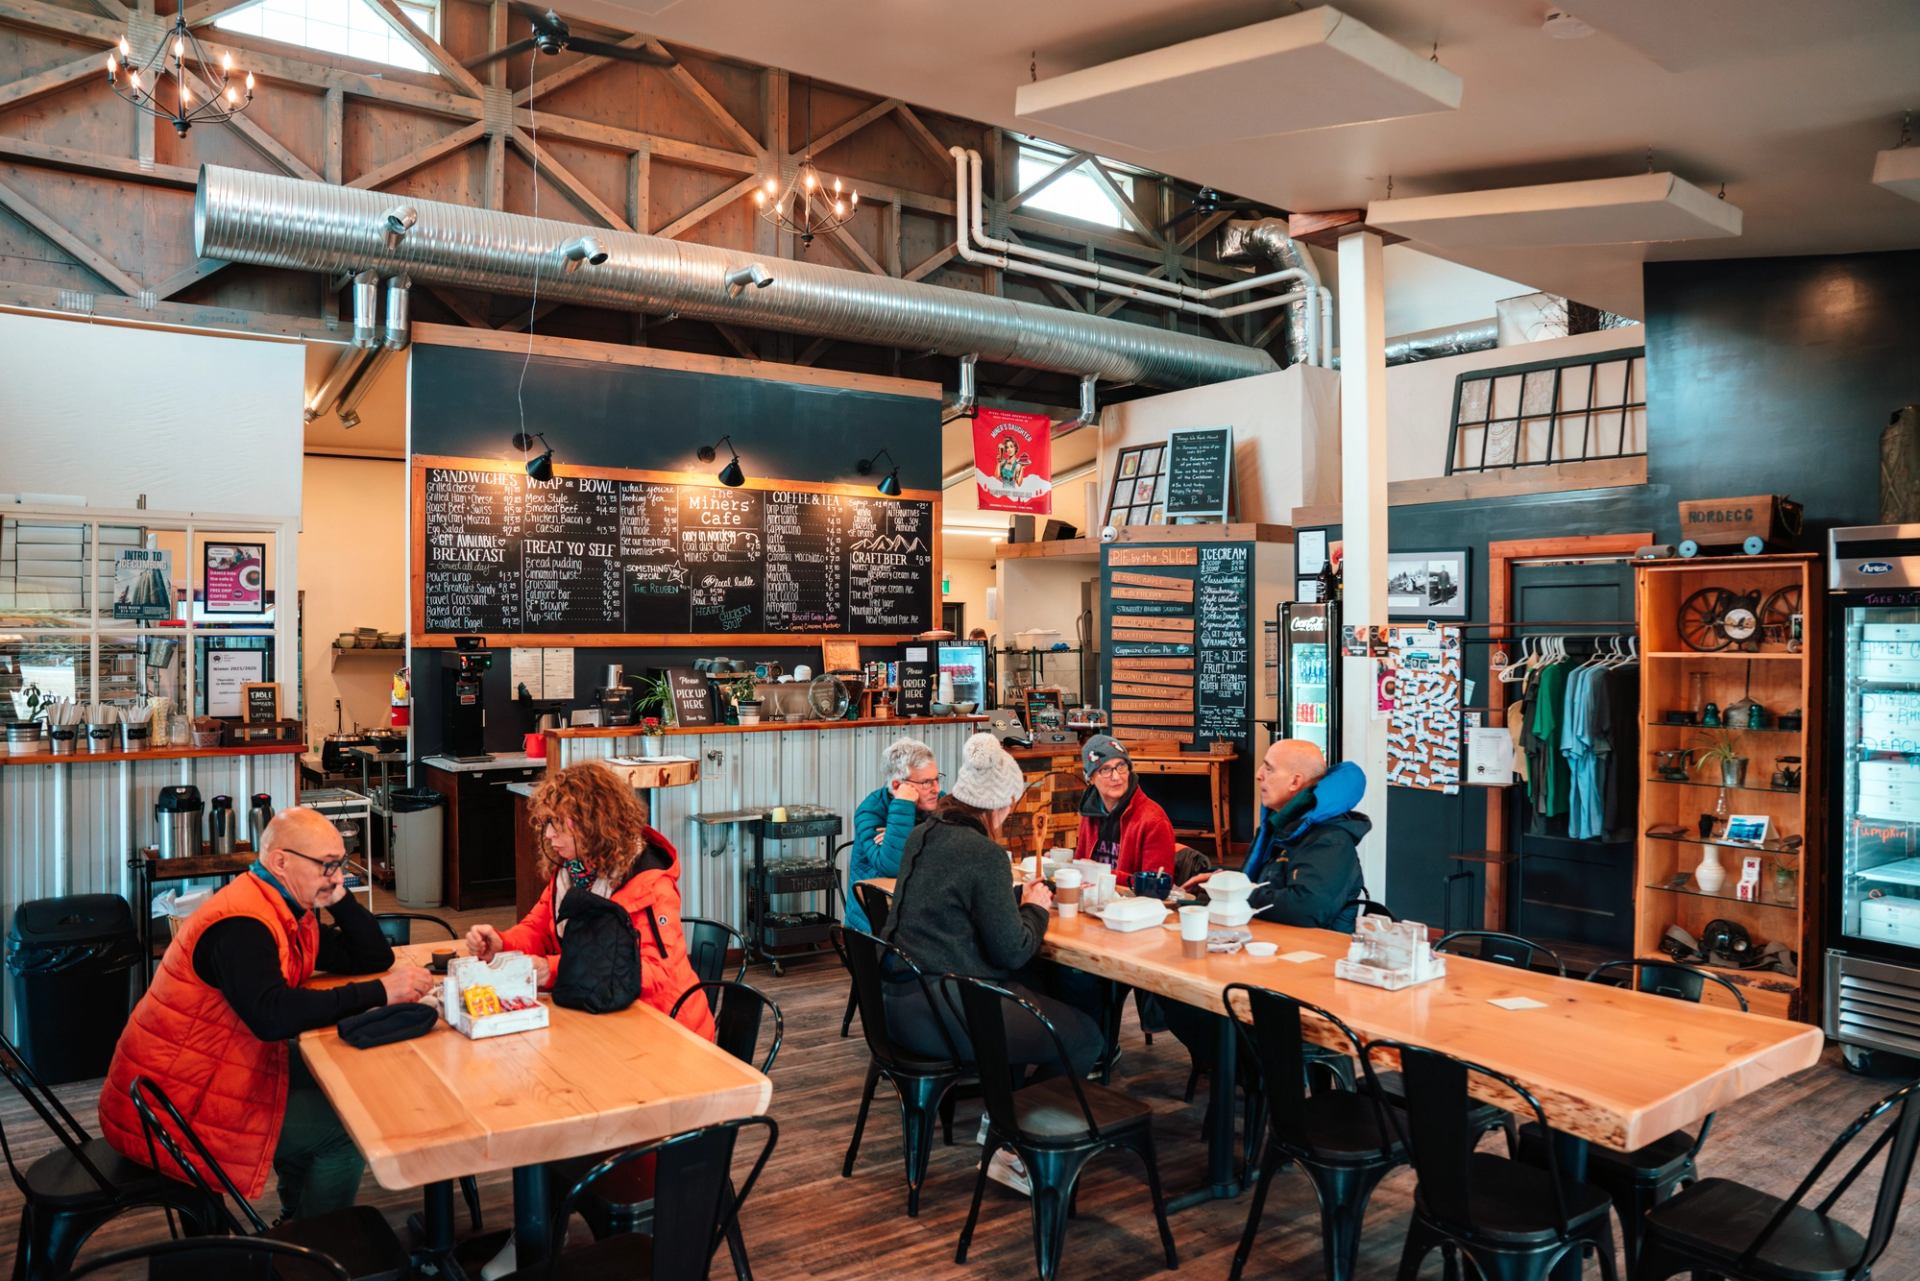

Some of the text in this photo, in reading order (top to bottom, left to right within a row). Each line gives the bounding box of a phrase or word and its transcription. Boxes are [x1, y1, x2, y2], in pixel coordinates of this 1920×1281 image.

[433, 468, 518, 487] SANDWICHES
[427, 481, 476, 494] Grilled cheese
[526, 475, 616, 494] WRAP BOWL
[621, 483, 644, 494] what
[426, 492, 449, 503] Grilled
[525, 492, 569, 506] Mexi Style
[709, 488, 734, 499] The
[772, 491, 840, 506] COFFEE & TEA
[621, 493, 665, 507] looking for
[688, 495, 755, 512] Miners'
[426, 502, 492, 515] Roast Beef Swiss
[525, 502, 579, 514] Smoked Beef
[467, 514, 490, 525] Mozza
[560, 514, 584, 525] Bacon
[621, 516, 641, 526] Cream
[701, 511, 742, 525] Cafe
[1688, 507, 1754, 524] NORDEGG
[427, 523, 465, 538] Egg Salad
[535, 524, 565, 533] Caesar
[621, 537, 635, 547] See
[635, 539, 644, 547] our
[707, 529, 736, 545] Nordegg
[524, 539, 565, 554] TREAT
[588, 542, 617, 558] SELF
[631, 547, 644, 556] oven
[682, 542, 698, 552] Coal
[699, 540, 716, 552] dust
[124, 549, 162, 562] INTRO TO
[433, 547, 506, 562] BREAKFAST
[684, 552, 728, 562] Miners' Chai
[852, 551, 908, 566] CRAFT BEER
[1112, 549, 1129, 566] PIE
[1141, 551, 1158, 562] the
[1161, 548, 1193, 565] SLICE
[474, 563, 490, 576] day
[525, 556, 582, 574] Bread pudding
[625, 564, 669, 574] SOMETHING
[427, 572, 471, 584] Power wrap
[525, 569, 558, 579] Cinnamon
[636, 571, 662, 580] SPECIAL
[766, 572, 791, 583] Matcha
[525, 579, 559, 591] Croissant
[714, 576, 732, 587] local
[426, 581, 496, 597] Best Breakfast Sandy
[525, 589, 571, 600] Eatmore Bar
[692, 588, 704, 598] Cup
[451, 592, 488, 606] Croissant
[1864, 594, 1893, 604] TAKE
[426, 605, 472, 616] Baked Oats
[540, 600, 570, 611] Brownie
[695, 605, 726, 616] HEARTY
[719, 604, 752, 621] CHICKEN
[464, 616, 483, 633] Bagel
[722, 618, 743, 631] SOUP
[1200, 649, 1248, 664] PIE SLICE
[905, 666, 923, 675] Please
[1203, 663, 1225, 674] FRUIT
[902, 678, 927, 689] ORDER
[250, 690, 272, 699] TABLE
[676, 688, 707, 699] PICK UP
[904, 689, 924, 698] HERE
[683, 699, 705, 710] HERE
[1852, 818, 1908, 843] Pumpkin
